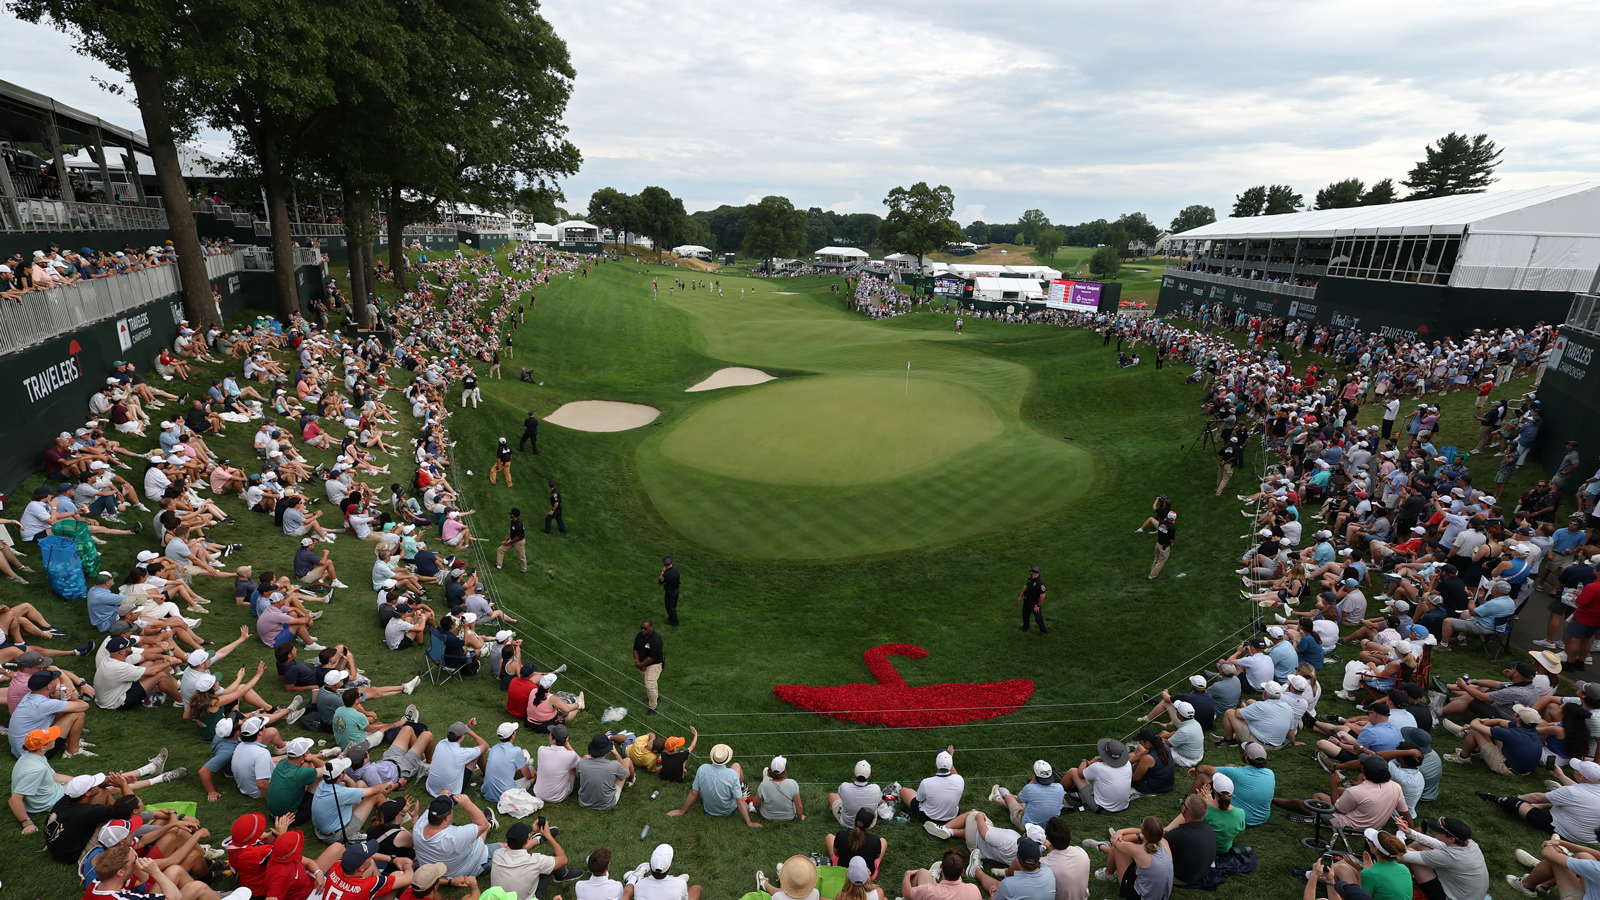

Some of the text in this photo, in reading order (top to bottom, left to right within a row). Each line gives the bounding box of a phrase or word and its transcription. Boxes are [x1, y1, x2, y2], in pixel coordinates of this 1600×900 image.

[1299, 303, 1318, 314] TRAVELERS
[127, 312, 149, 332] TRAVELERS
[1381, 325, 1418, 344] TRAVELERS
[1565, 341, 1595, 366] TRAVELERS
[22, 357, 79, 403] TRAVELERS
[338, 880, 362, 894] HAALAND
